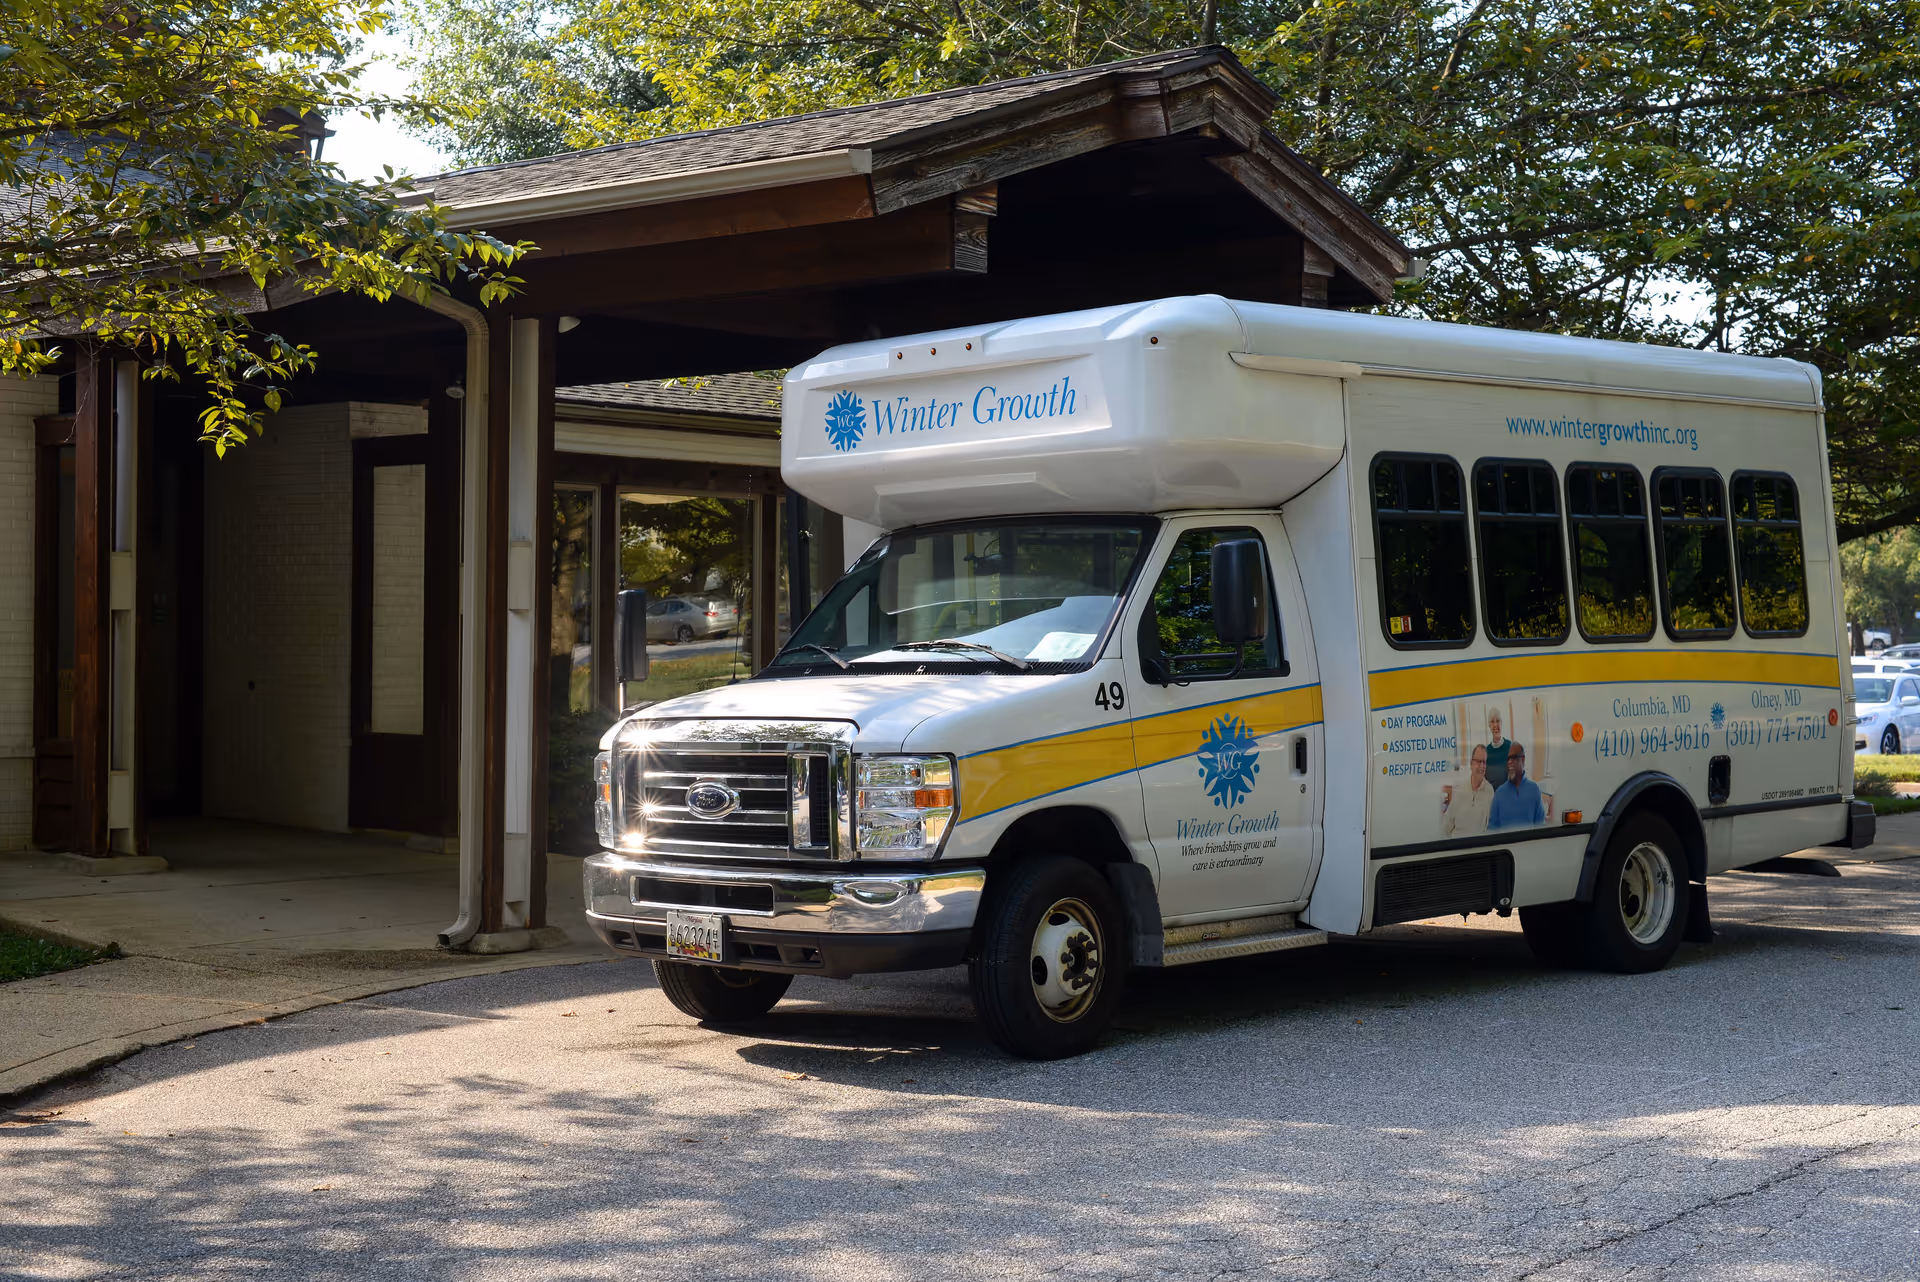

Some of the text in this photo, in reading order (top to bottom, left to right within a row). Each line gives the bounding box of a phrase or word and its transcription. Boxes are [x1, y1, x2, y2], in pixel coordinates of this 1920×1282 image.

[872, 376, 1077, 436] Winter Growth
[1506, 415, 1698, 450] www.wintergrowthinc.org
[1094, 681, 1125, 711] 49
[1613, 695, 1691, 718] Columbia, MD
[1751, 688, 1801, 711] Olney, MD
[1387, 714, 1447, 729] DAY PROGRAM
[1725, 715, 1827, 750] (301) 774-7501
[1389, 736, 1456, 753] ASSISTED LIVING
[1594, 723, 1710, 763] (410) 964-9616
[1216, 751, 1242, 772] WG
[1388, 760, 1446, 776] RESPITE CARE
[1177, 810, 1279, 840] Winter Growth
[1182, 836, 1277, 856] Where friendships grow and
[1192, 855, 1264, 871] care is extraordinary
